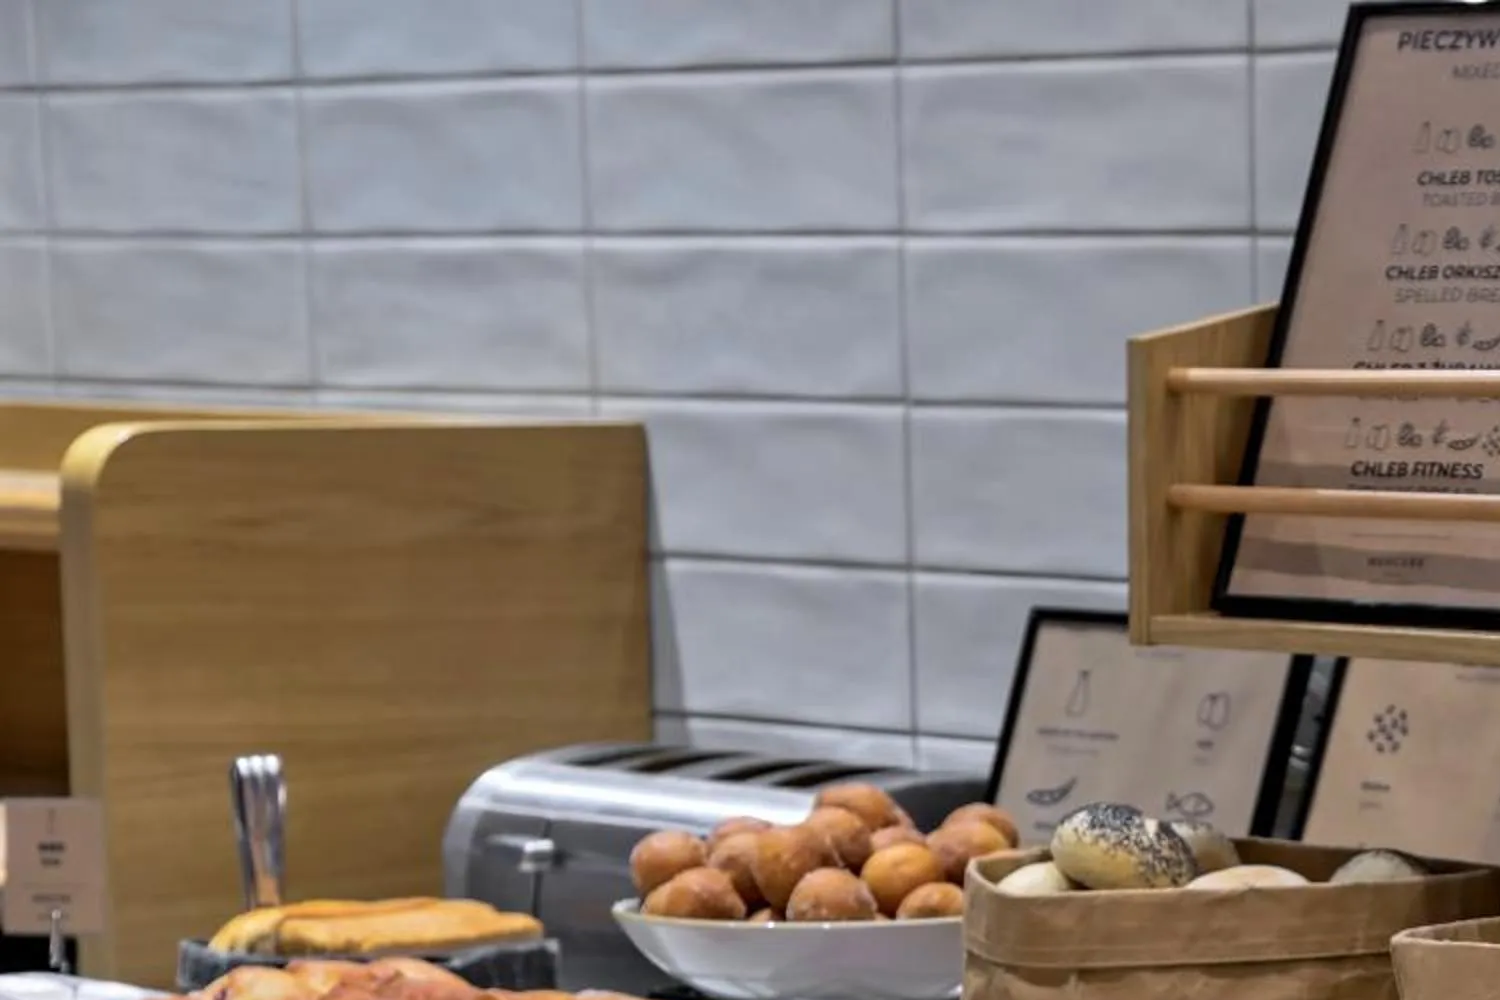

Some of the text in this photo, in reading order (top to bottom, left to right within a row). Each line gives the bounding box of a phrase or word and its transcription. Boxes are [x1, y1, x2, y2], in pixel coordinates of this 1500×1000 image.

[1417, 170, 1471, 187] CHLEB
[1386, 265, 1440, 283] CHLEB
[1350, 460, 1484, 480] CHLEB FITNESS
